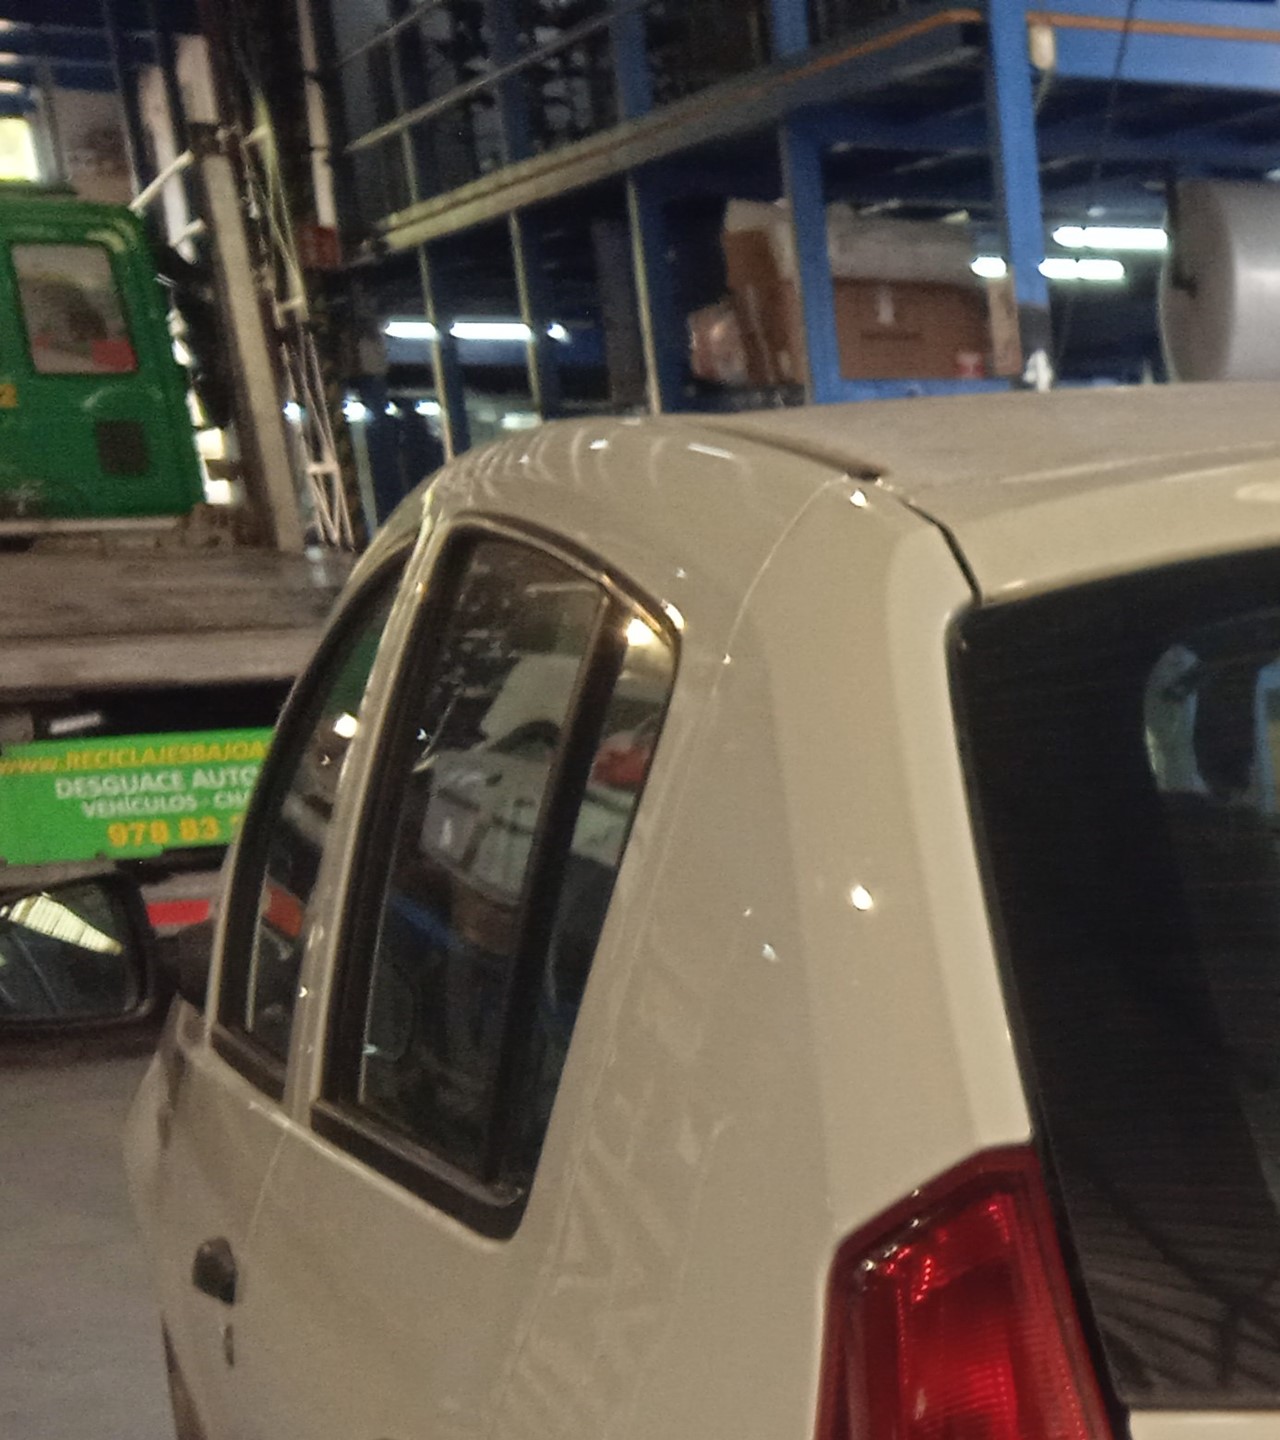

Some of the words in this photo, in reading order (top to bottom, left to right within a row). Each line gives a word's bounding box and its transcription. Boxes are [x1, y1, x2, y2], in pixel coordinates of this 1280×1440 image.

[54, 770, 185, 800] DESGUACE
[107, 820, 169, 849] 978
[179, 815, 219, 843] 83
